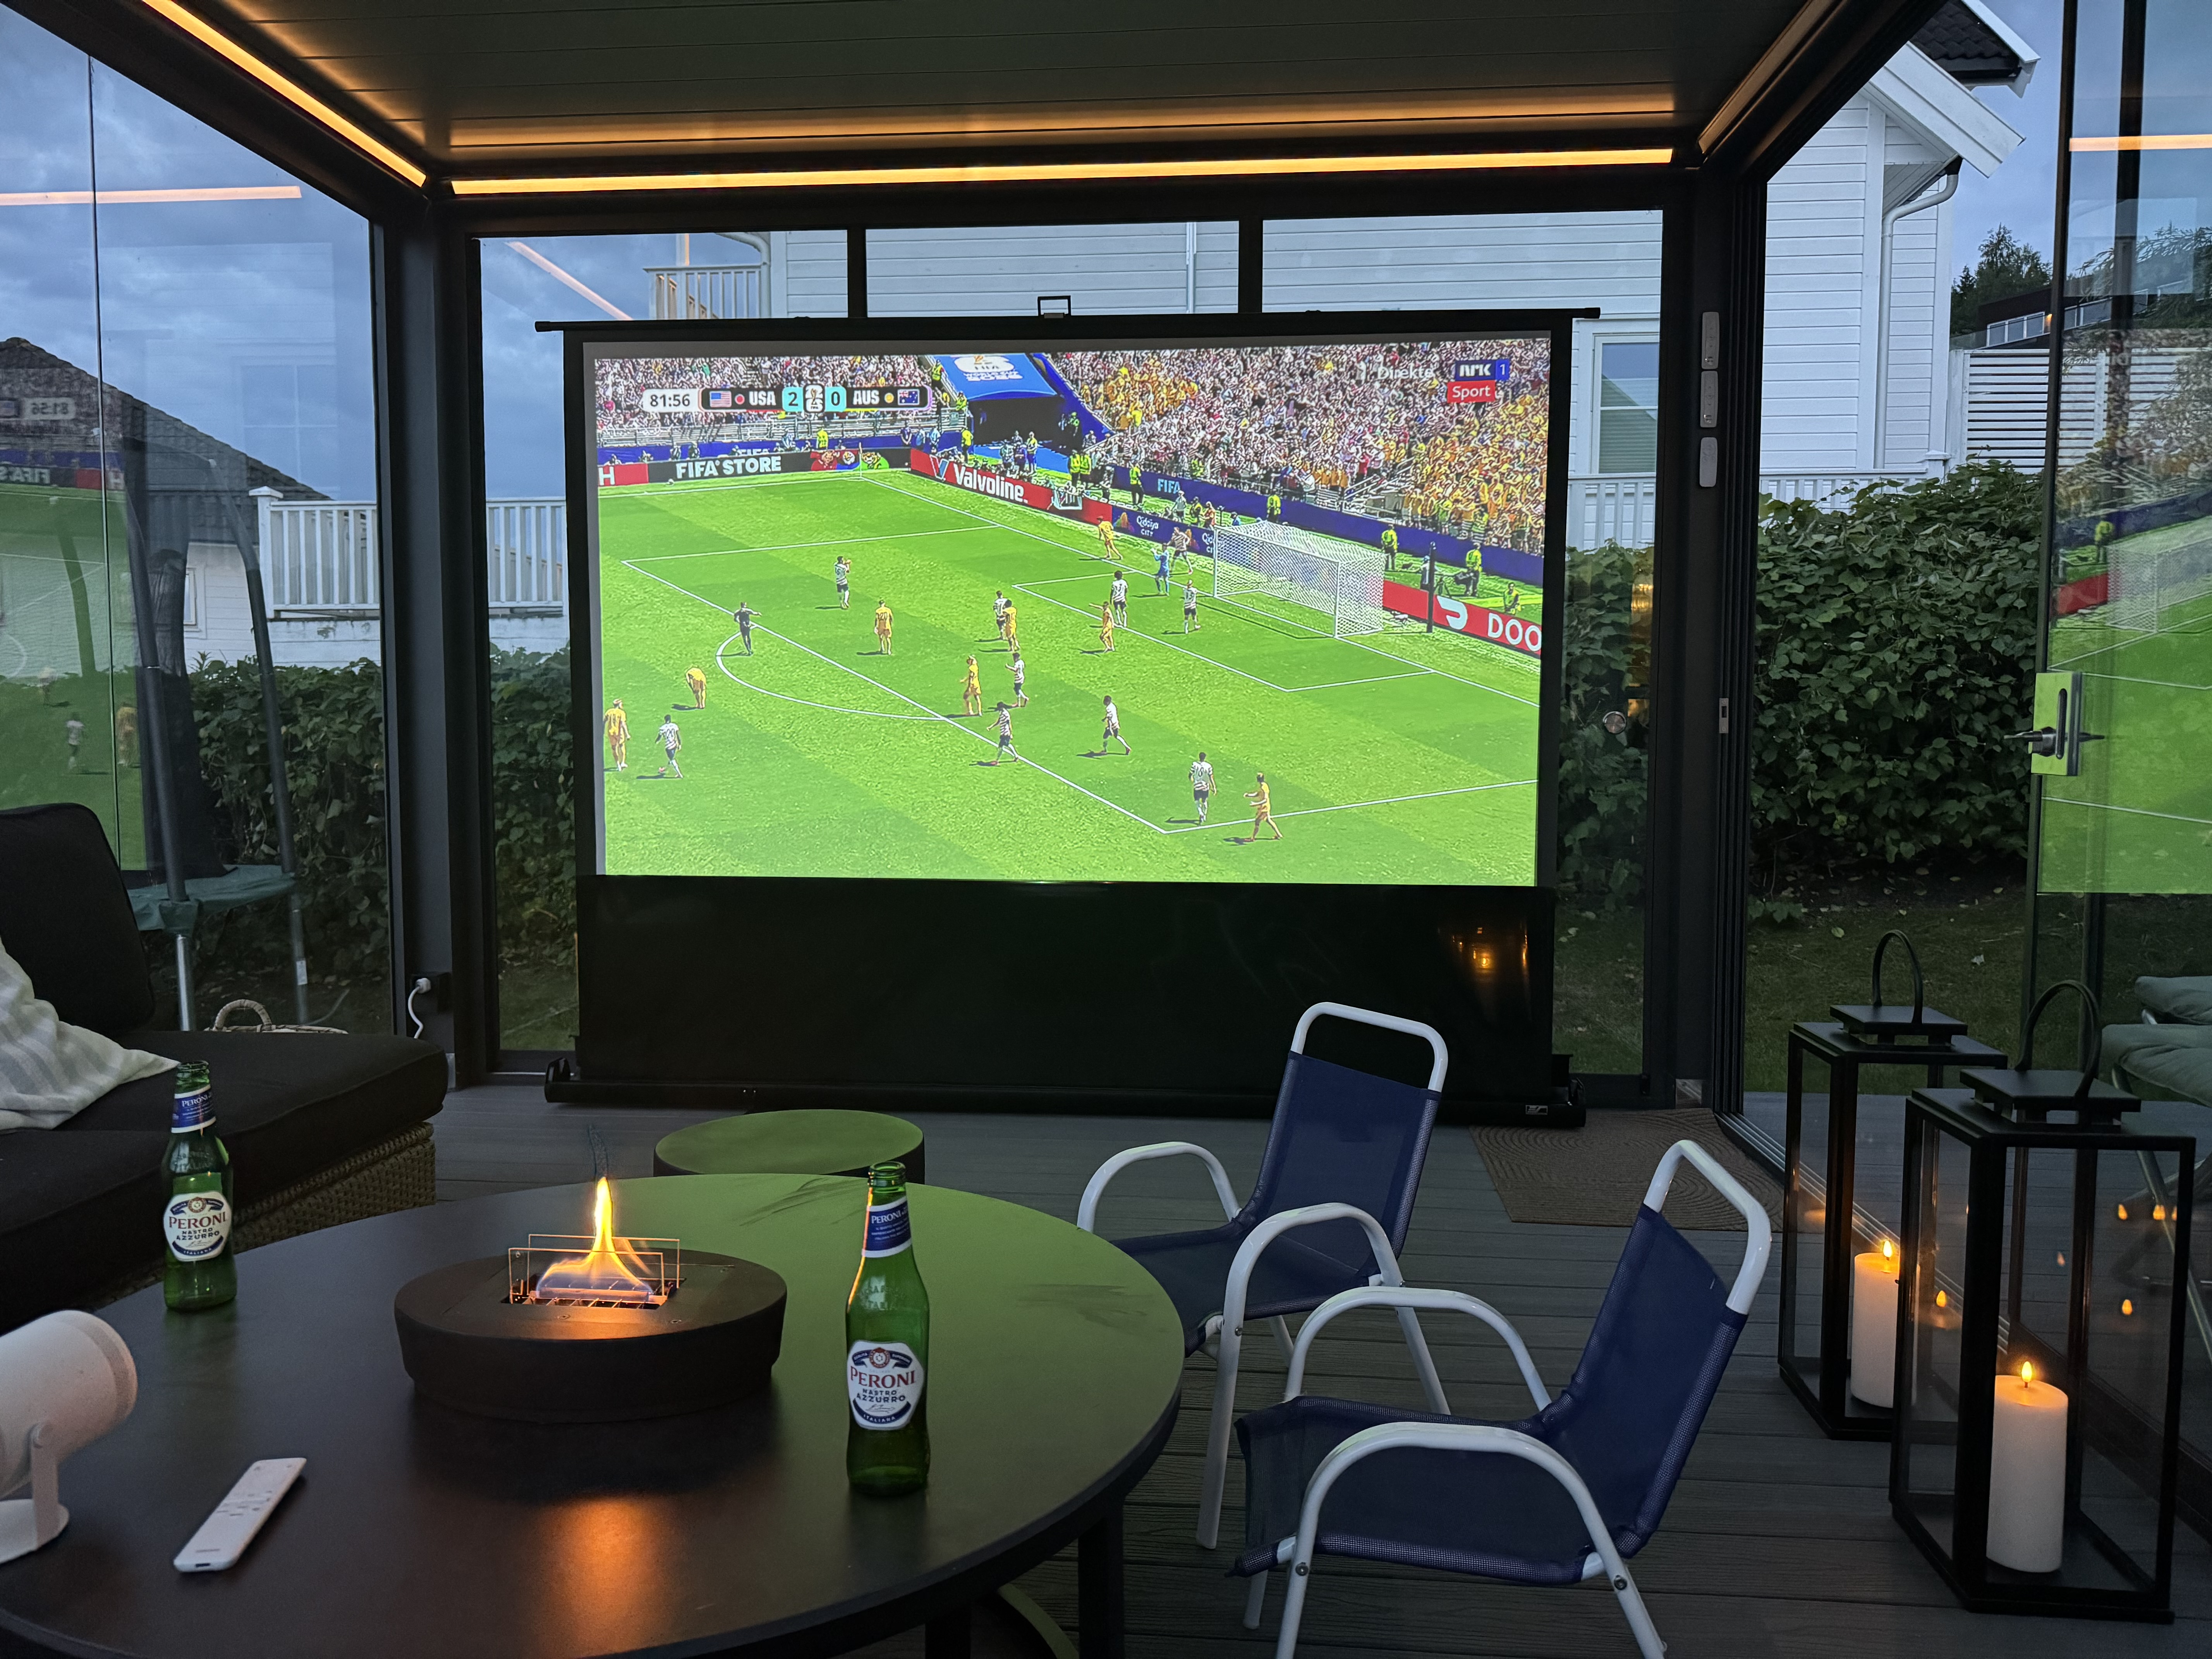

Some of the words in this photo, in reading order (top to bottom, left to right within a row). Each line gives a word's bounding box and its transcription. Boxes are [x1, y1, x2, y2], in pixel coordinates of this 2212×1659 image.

[1377, 364, 1434, 380] Direkte
[1500, 364, 1505, 376] 1
[650, 393, 690, 407] 81:56
[749, 391, 776, 406] USA
[788, 392, 799, 407] 2
[831, 391, 840, 406] 0
[853, 390, 880, 405] AUS
[1452, 386, 1491, 400] Sport
[676, 460, 718, 479] FIFA
[723, 456, 781, 475] STORE
[598, 466, 615, 486] H
[1157, 478, 1180, 494] FIFA
[1487, 613, 1542, 652] DOO
[169, 1212, 226, 1229] PERONI
[871, 1210, 901, 1224] PERONI
[177, 1231, 220, 1240] AZZURRO
[850, 1366, 916, 1389] PERONI
[856, 1393, 906, 1403] AZZURRO
[864, 1414, 896, 1422] ITALIANA
